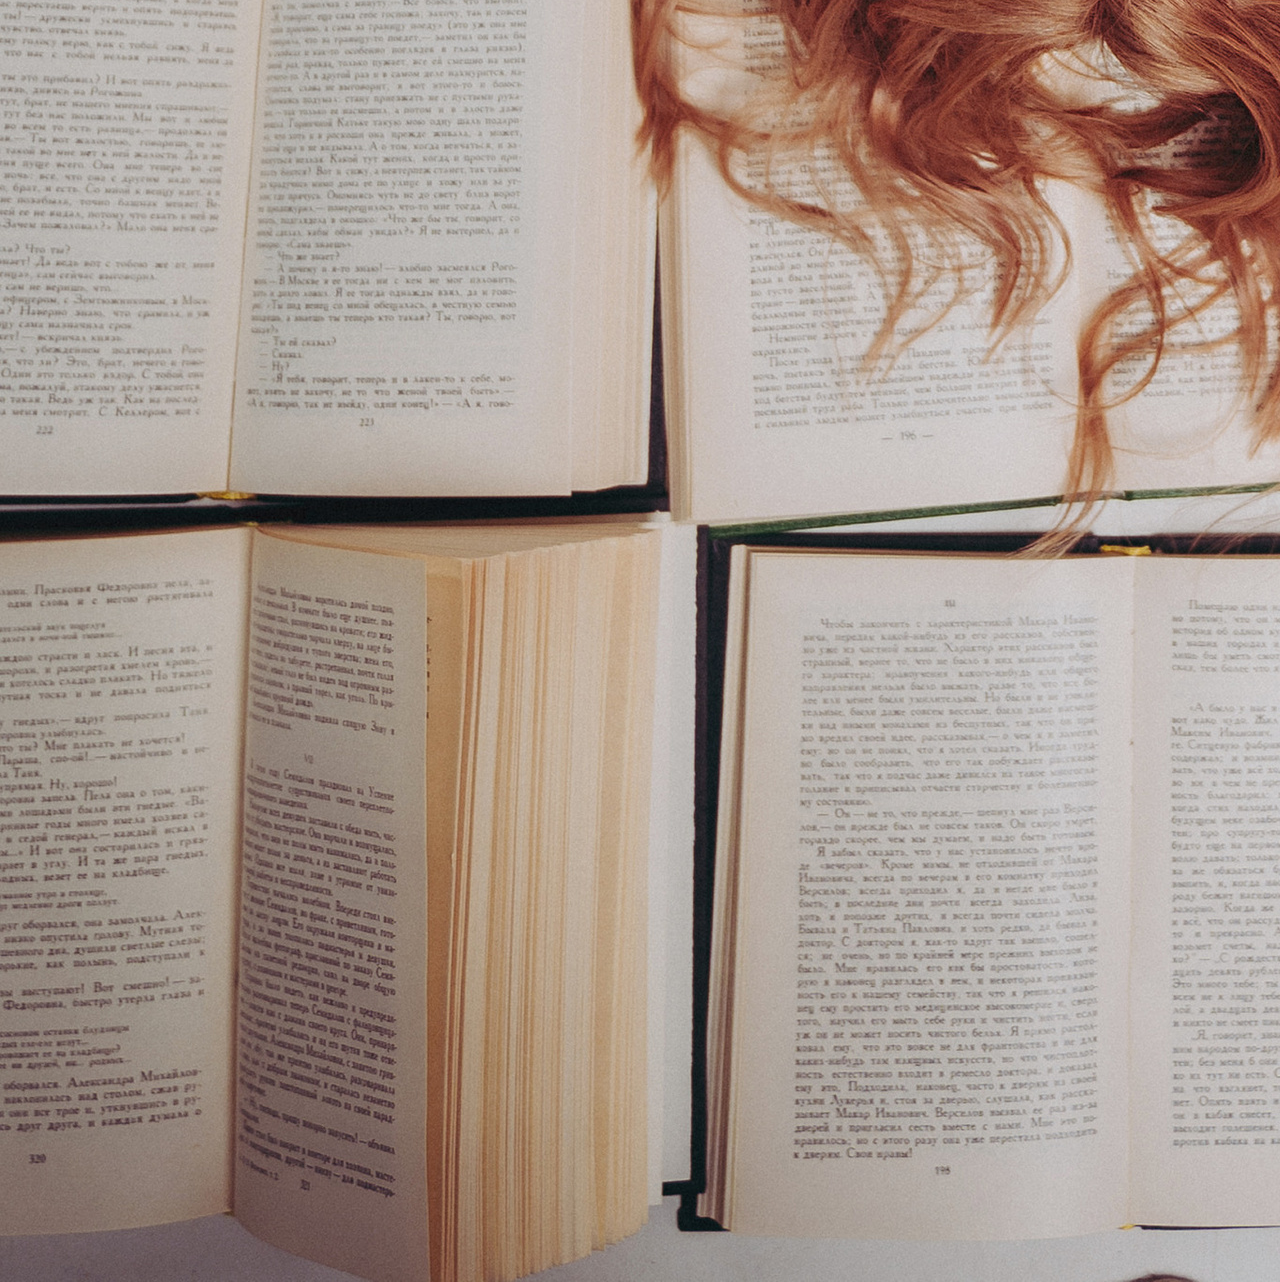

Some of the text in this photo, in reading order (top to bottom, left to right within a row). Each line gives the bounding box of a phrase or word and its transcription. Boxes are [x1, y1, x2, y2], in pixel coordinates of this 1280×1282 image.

[900, 431, 917, 441] 196
[120, 739, 133, 747] не
[139, 790, 147, 798] о
[197, 988, 204, 996] и
[28, 1154, 47, 1164] 320
[934, 1165, 951, 1175] 198
